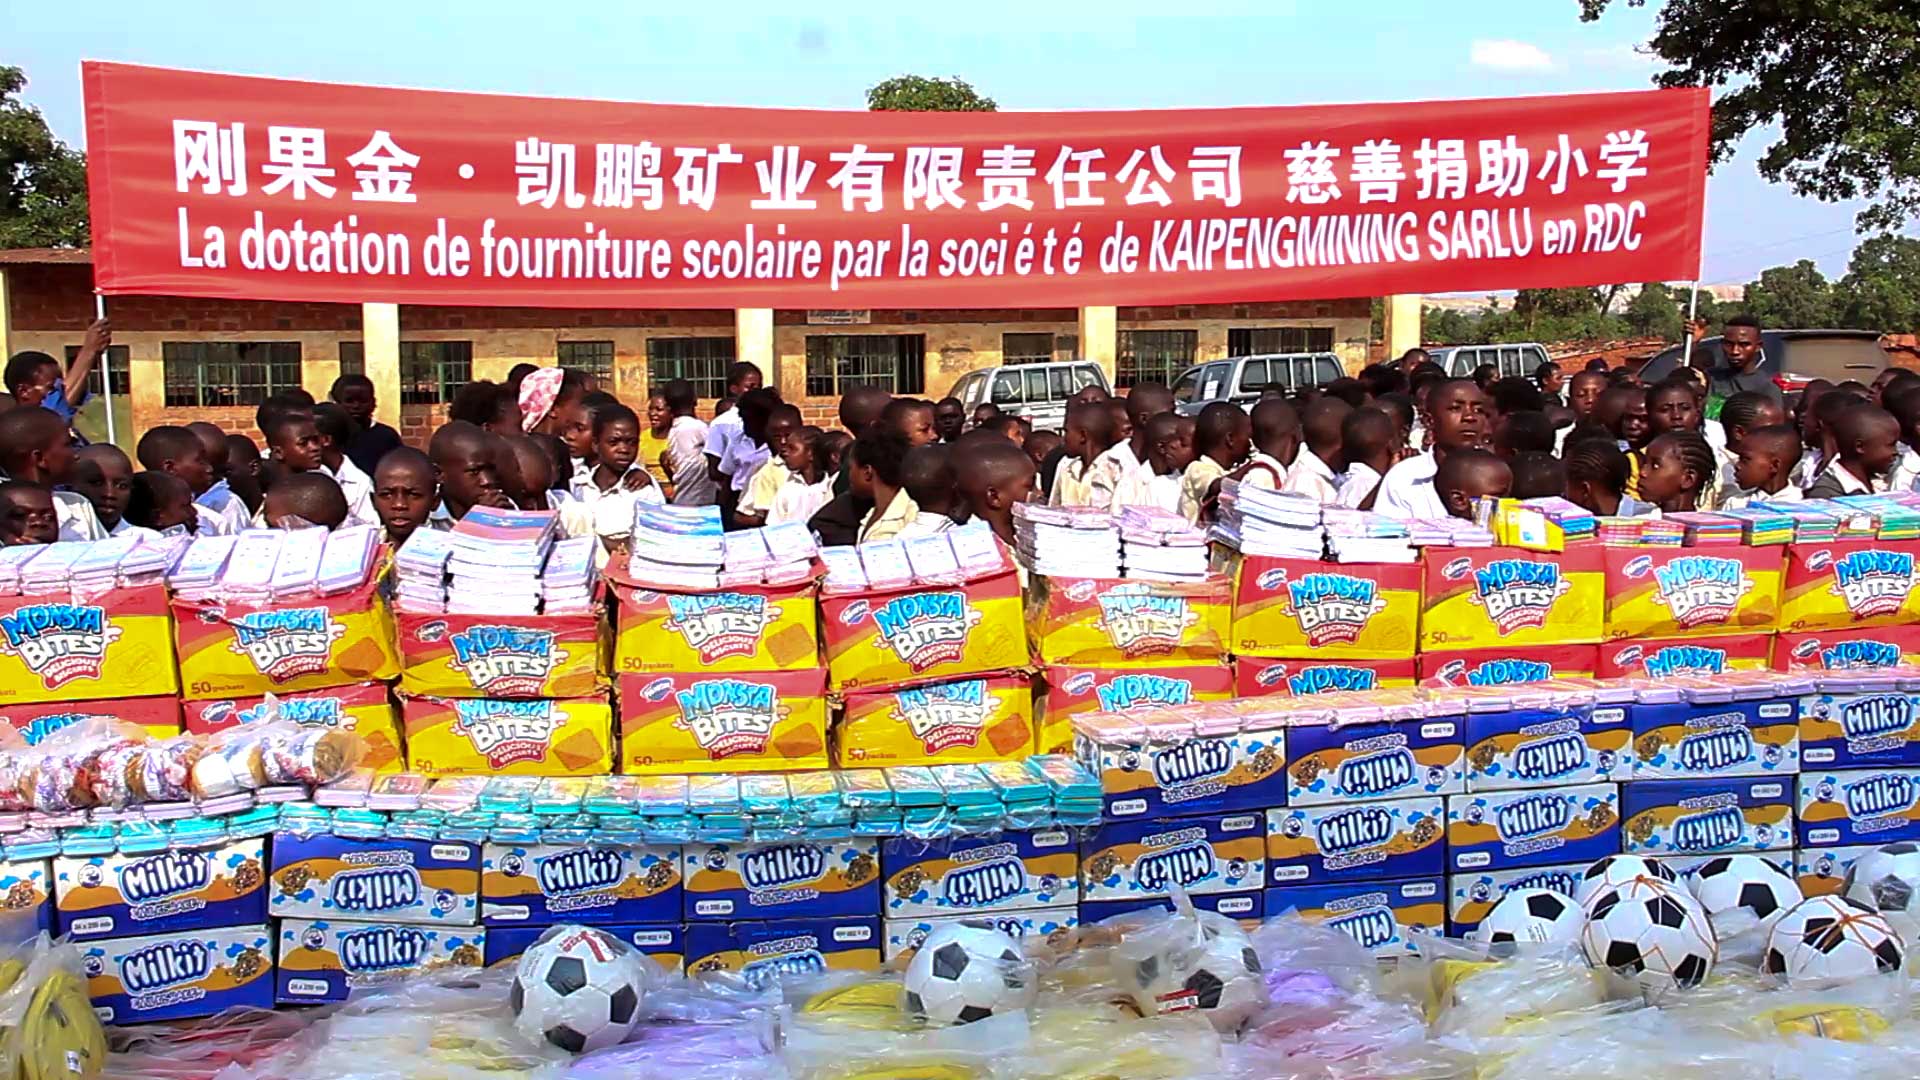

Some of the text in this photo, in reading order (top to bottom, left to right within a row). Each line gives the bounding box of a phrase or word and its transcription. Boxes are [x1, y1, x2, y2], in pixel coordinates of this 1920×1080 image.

[1284, 129, 1650, 206] 慈善捐助小学
[179, 206, 226, 268] La
[239, 210, 409, 275] dotation
[423, 218, 471, 277] de
[480, 218, 672, 280] fourniture
[682, 222, 821, 279] scolaire
[830, 235, 890, 291] par
[898, 223, 929, 277] la
[1099, 218, 1138, 274] de
[1149, 210, 1417, 273] KAIPENGMINING
[1427, 207, 1531, 262] SARLU
[1543, 217, 1577, 254] en
[1584, 201, 1646, 251] RDC
[1476, 561, 1557, 596] MONSTA
[1657, 558, 1740, 595] MONSTA
[1836, 551, 1912, 587] MONSTA
[668, 593, 764, 623] MONSTA
[1289, 575, 1373, 608] MONSTA
[1485, 588, 1553, 618] BITES
[1669, 586, 1738, 618] BITES
[1845, 577, 1909, 609] BITES
[1, 605, 101, 646] MONSTA
[236, 609, 325, 644] MONSTA
[682, 613, 763, 646] BITES
[874, 593, 963, 638] MONSTA
[1111, 617, 1181, 646] BITES
[1299, 601, 1369, 630] BITES
[20, 633, 103, 670] BITES
[251, 634, 328, 670] BITES
[453, 627, 550, 663] MONSTA
[893, 621, 965, 660] BITES
[1241, 640, 1257, 650] 50
[1431, 632, 1447, 644] 50
[470, 655, 549, 687] BITES
[623, 657, 642, 669] 50
[1468, 659, 1549, 686] MONSTA
[1645, 649, 1723, 677] MONSTA
[191, 682, 211, 694] 50
[842, 678, 858, 690] 50
[1100, 676, 1188, 711] MONSTA
[1289, 667, 1373, 696] MONSTA
[458, 699, 550, 727] MONSTA
[678, 682, 772, 721] MONSTA
[1847, 697, 1909, 733] Milkit
[472, 718, 550, 751] BITES
[693, 712, 772, 746] BITES
[910, 703, 983, 737] BITES
[415, 760, 432, 772] 50
[634, 756, 652, 766] 50
[848, 748, 866, 760] 50
[1157, 741, 1229, 784] Milkit
[1518, 738, 1585, 776] Milkit
[1683, 732, 1747, 769] Milkit
[1341, 751, 1412, 794] Milkit
[1851, 777, 1913, 815] Milkit
[1322, 808, 1391, 850] Milkit
[1501, 798, 1569, 839] Milkit
[1678, 810, 1740, 849] Milkit
[123, 854, 207, 899] Milkit
[542, 850, 621, 890] Milkit
[745, 848, 823, 886] Milkit
[948, 861, 1022, 903] Milkit
[1140, 846, 1212, 887] Milkit
[337, 869, 417, 908] Milkit
[124, 942, 207, 988] Milkit
[344, 931, 427, 967] Milkit
